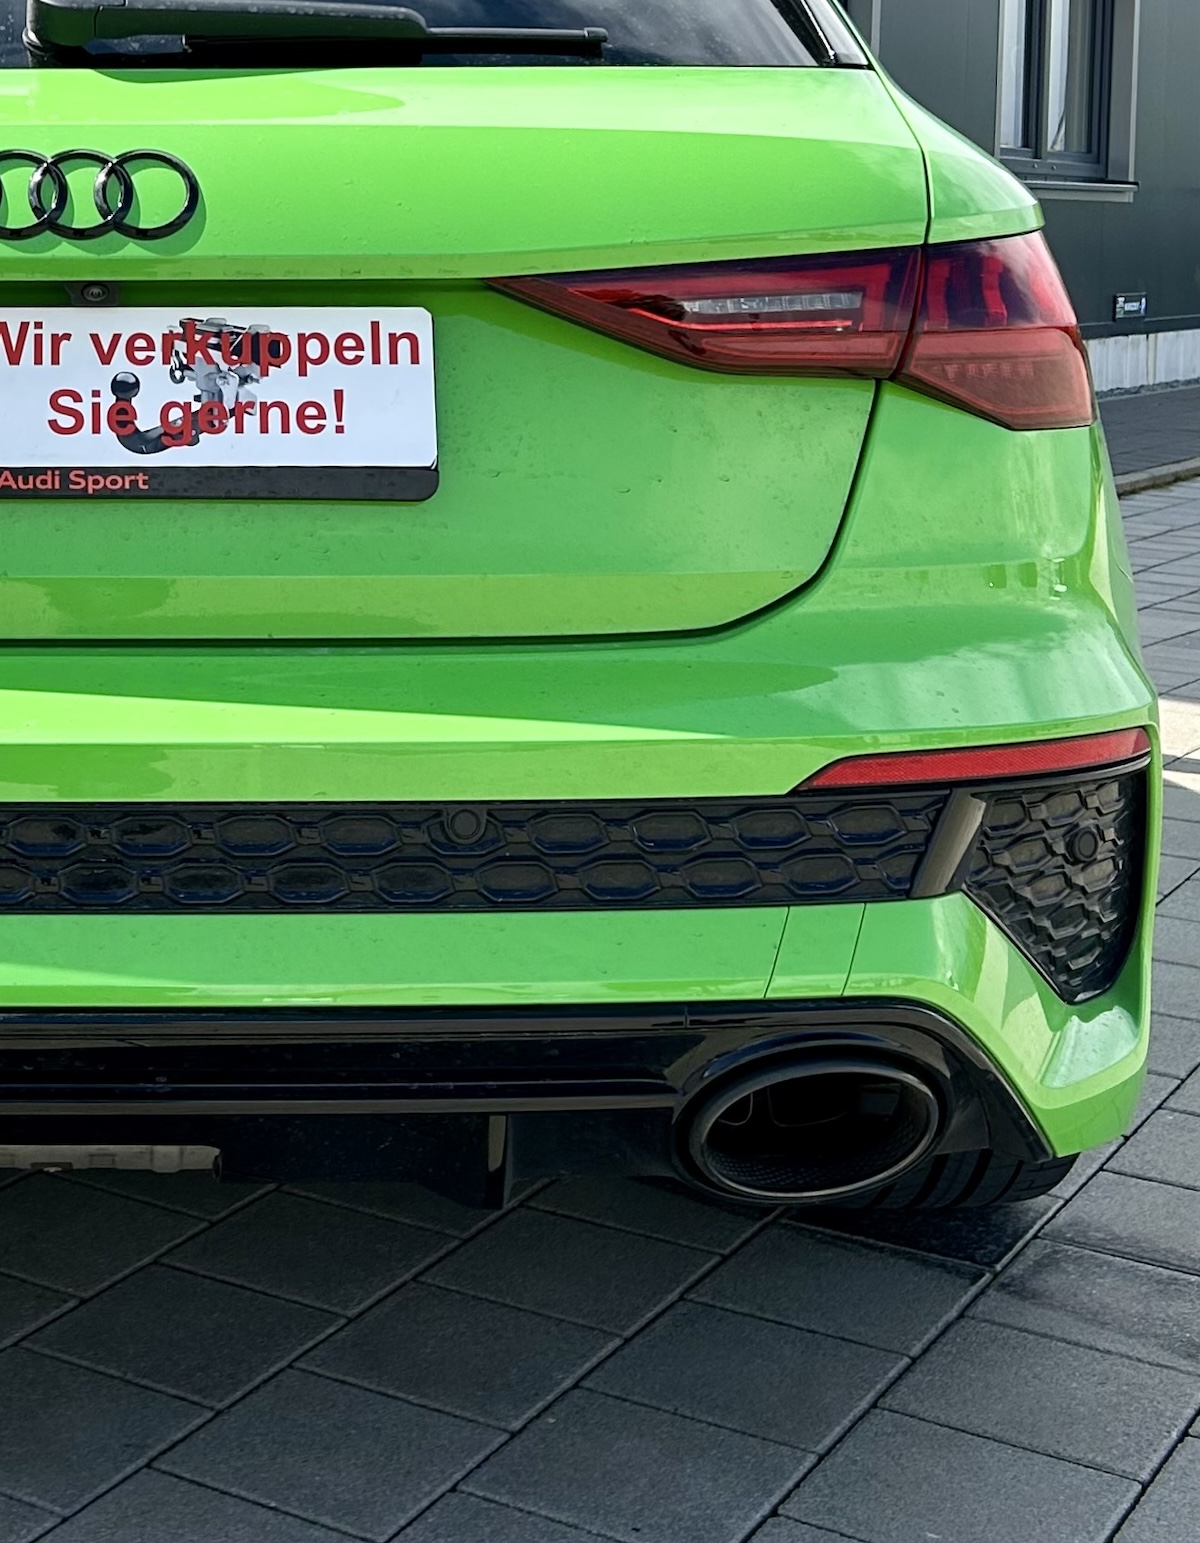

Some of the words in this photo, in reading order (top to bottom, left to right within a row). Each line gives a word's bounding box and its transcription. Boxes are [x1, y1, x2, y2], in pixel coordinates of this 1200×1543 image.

[90, 321, 420, 377] verkuppeln
[47, 388, 137, 435] Sie
[160, 388, 345, 448] gerne!
[68, 470, 149, 493] Sport
